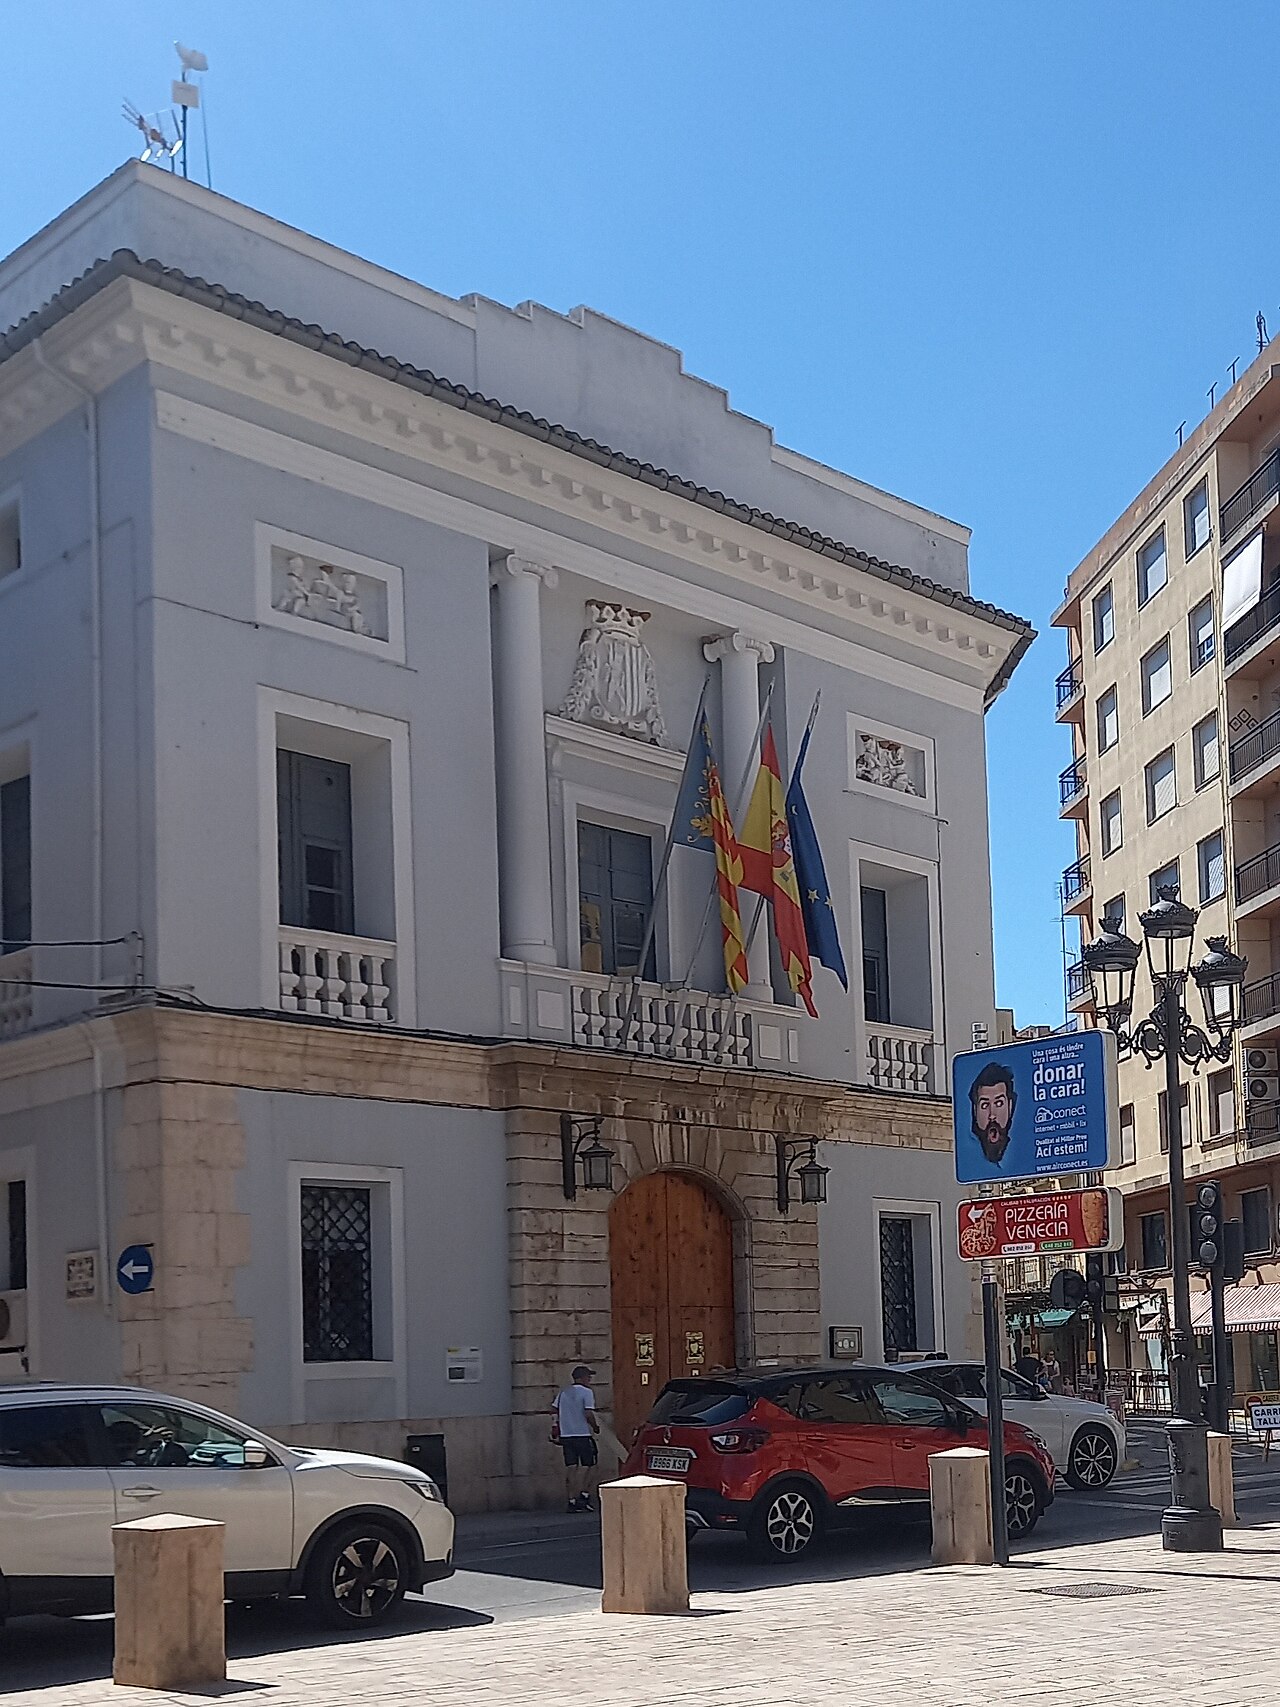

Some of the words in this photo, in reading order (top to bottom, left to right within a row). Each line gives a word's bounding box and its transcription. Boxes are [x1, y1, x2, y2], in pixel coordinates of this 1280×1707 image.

[1066, 1043, 1083, 1051] tindre
[1033, 1063, 1085, 1085] donar
[1034, 1085, 1046, 1101] la
[1050, 1078, 1085, 1099] cara!
[1035, 1125, 1055, 1133] internet
[1035, 1138, 1055, 1146] Qualitat
[1036, 1145, 1051, 1158] Ací
[1053, 1141, 1088, 1156] estem!
[1036, 1160, 1088, 1172] www.airconect.es
[1005, 1202, 1068, 1223] PIZZERÍA
[1005, 1221, 1068, 1240] VENECIA
[1254, 1408, 1280, 1416] CARR
